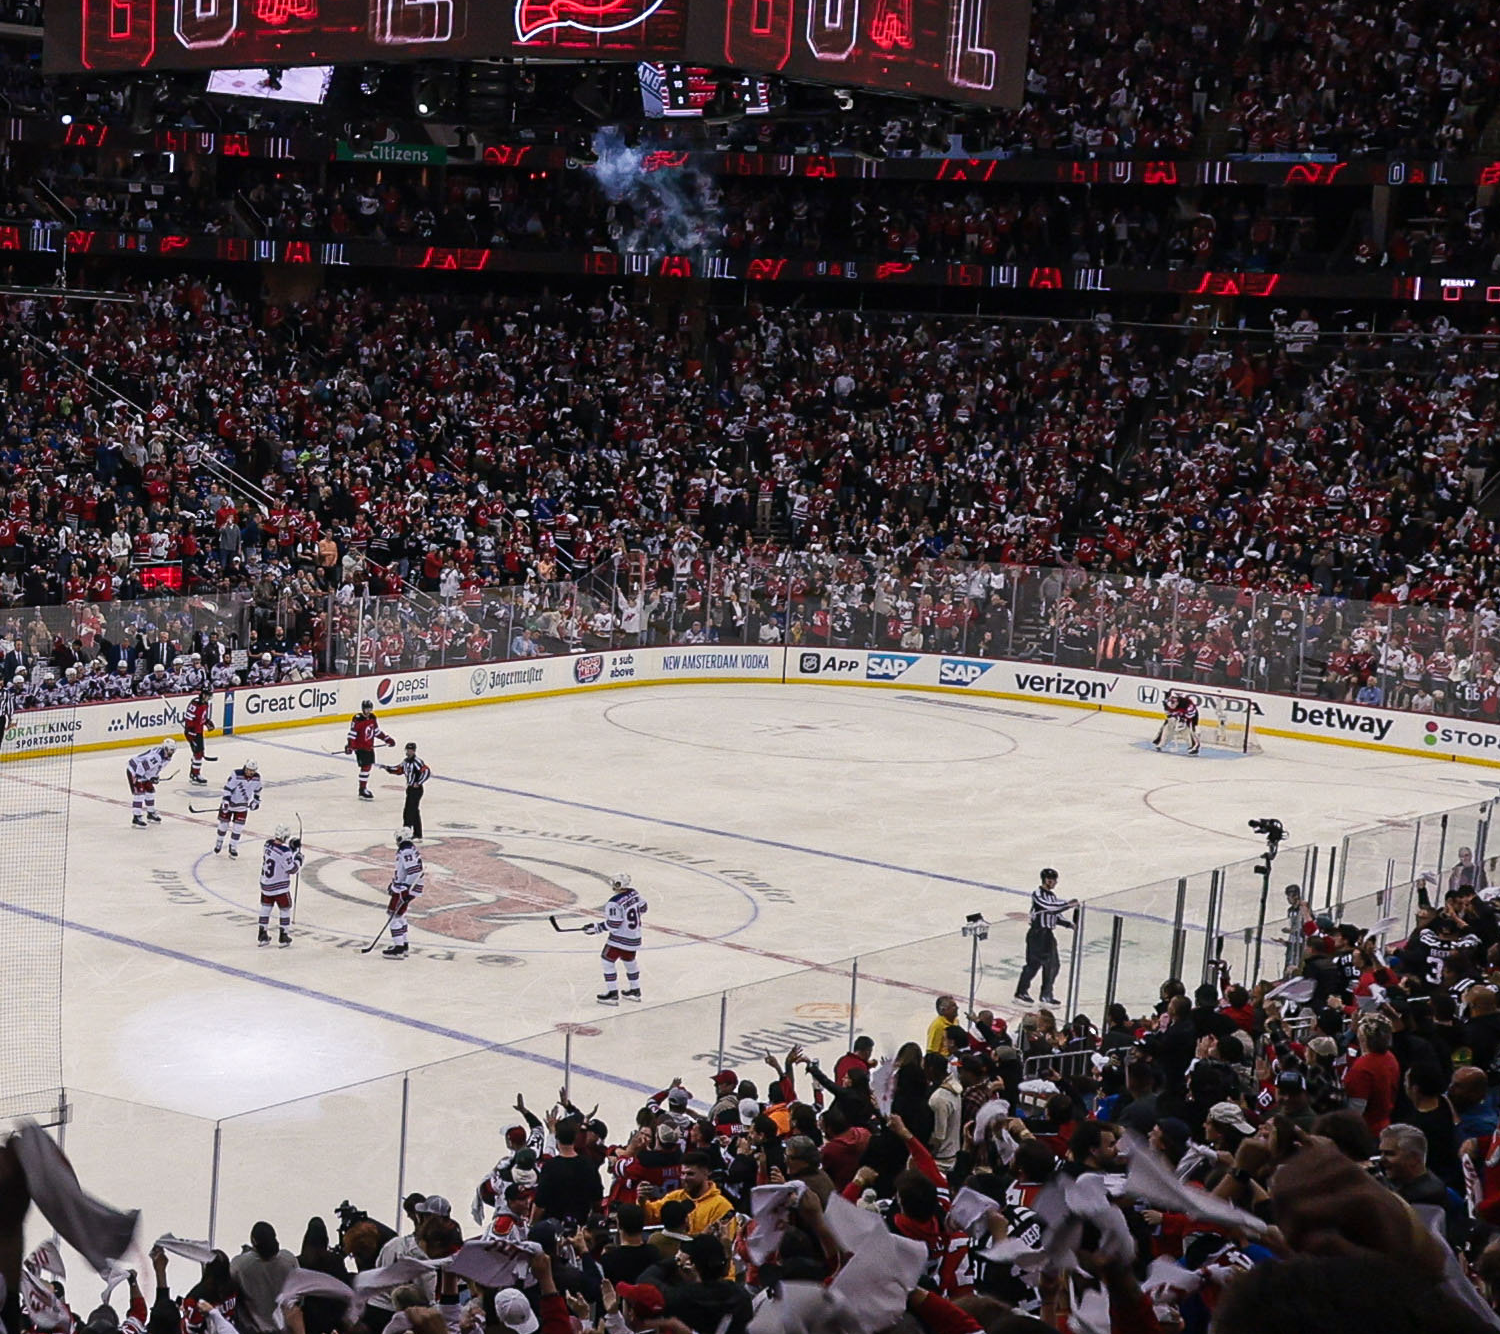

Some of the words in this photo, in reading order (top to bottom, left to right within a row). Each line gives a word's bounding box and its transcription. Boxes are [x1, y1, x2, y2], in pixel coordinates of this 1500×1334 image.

[370, 145, 428, 161] Citizens
[619, 655, 634, 665] sub
[663, 656, 680, 670] NEW
[682, 654, 737, 669] AMSTERDAM
[741, 654, 769, 669] VODKA
[868, 658, 907, 676] SAP
[610, 667, 635, 677] above
[940, 664, 982, 682] SAP
[396, 675, 429, 696] pepsi
[1016, 673, 1108, 701] verizon
[246, 693, 295, 714] Great
[299, 688, 337, 711] Clips
[411, 693, 428, 701] SUGAR
[1291, 702, 1393, 740] betway
[5, 720, 82, 741] DRAFTKINGS
[16, 733, 74, 749] SPORTSBOOK
